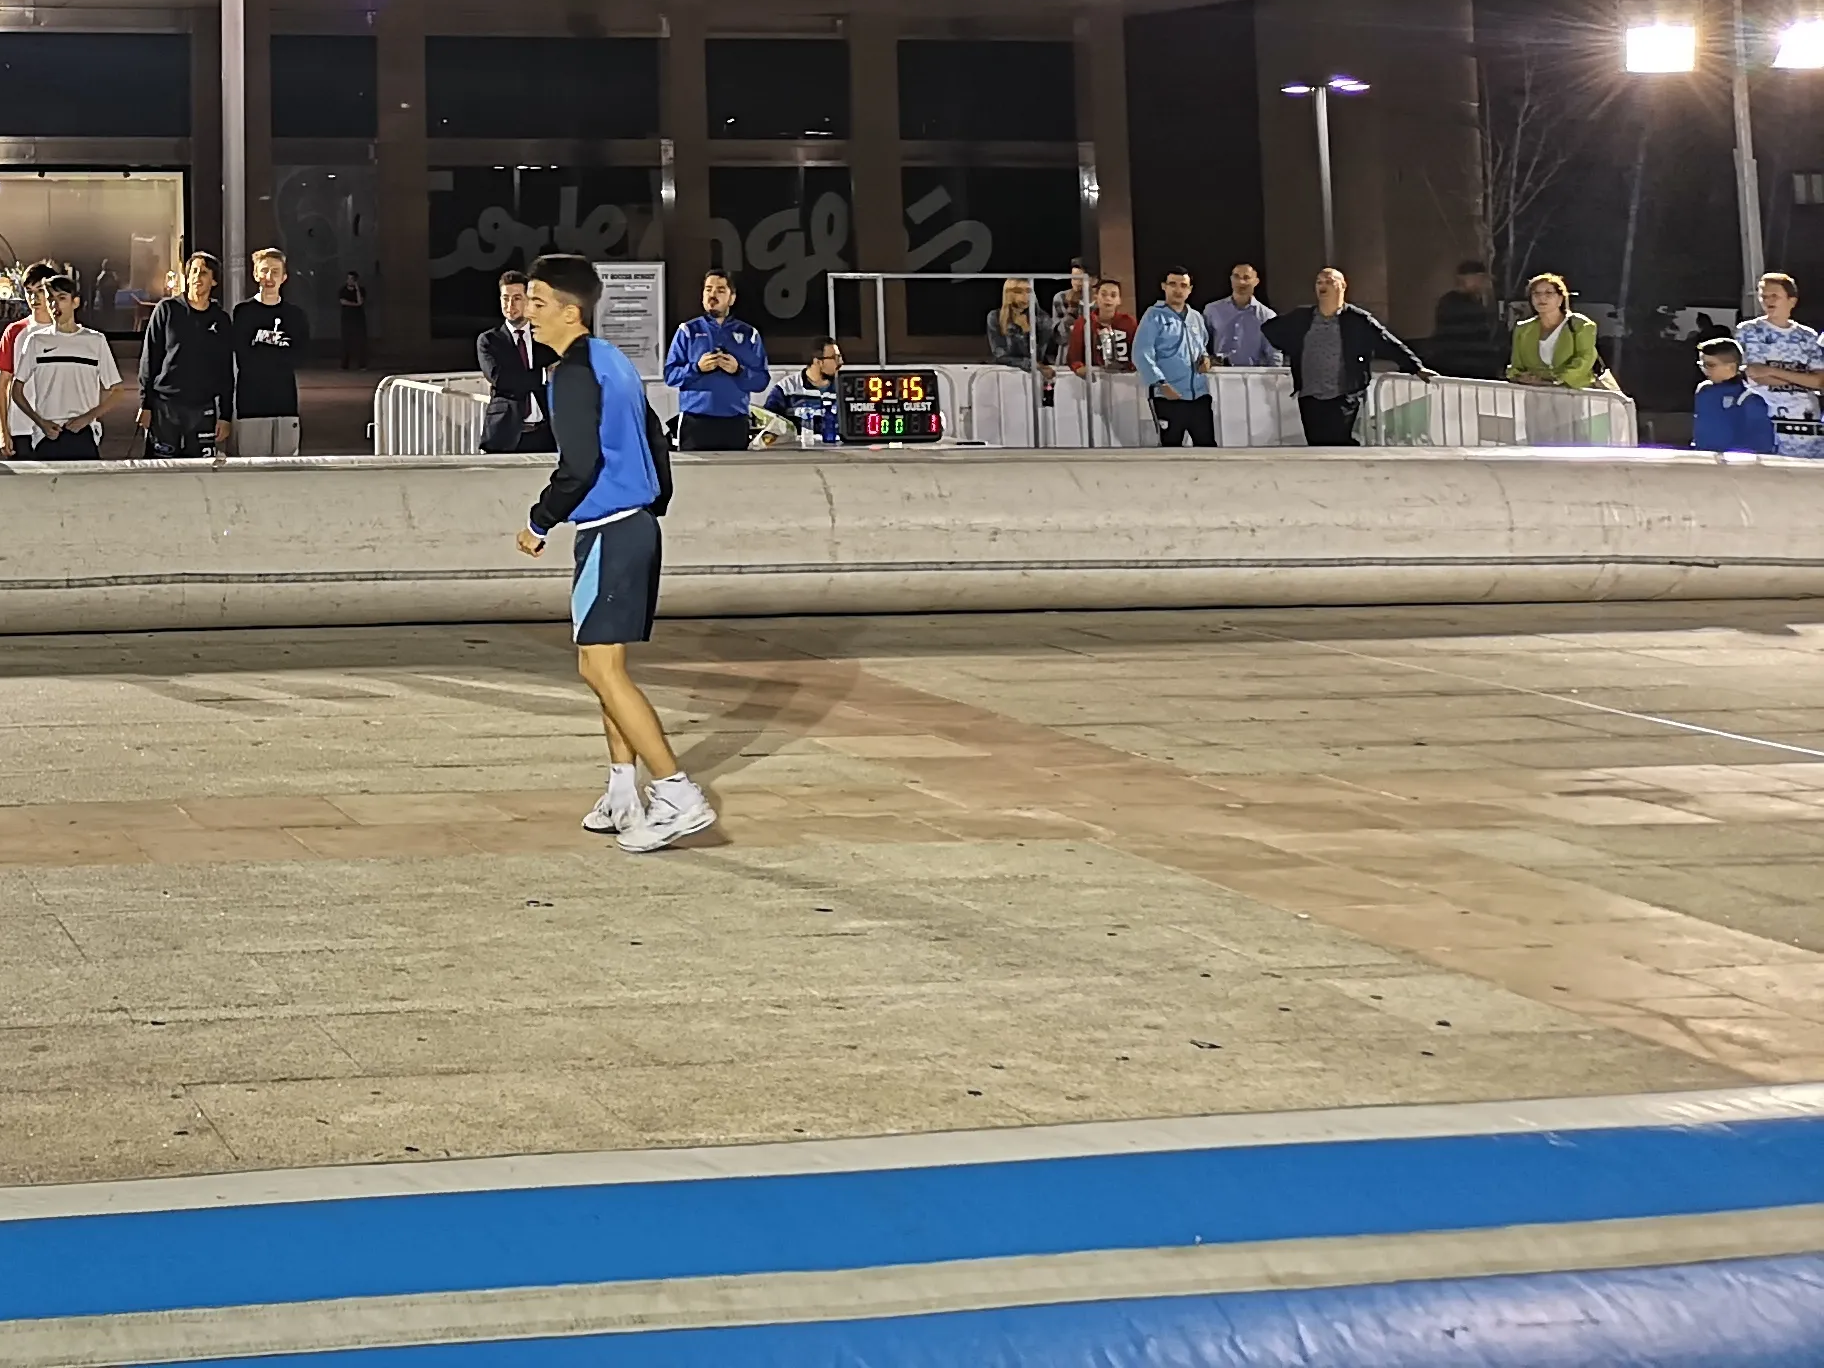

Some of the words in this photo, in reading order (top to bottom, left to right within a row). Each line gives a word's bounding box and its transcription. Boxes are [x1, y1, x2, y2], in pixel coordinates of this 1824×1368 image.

[868, 376, 924, 401] 9:15
[849, 402, 877, 412] HOME
[903, 401, 933, 412] GUEST
